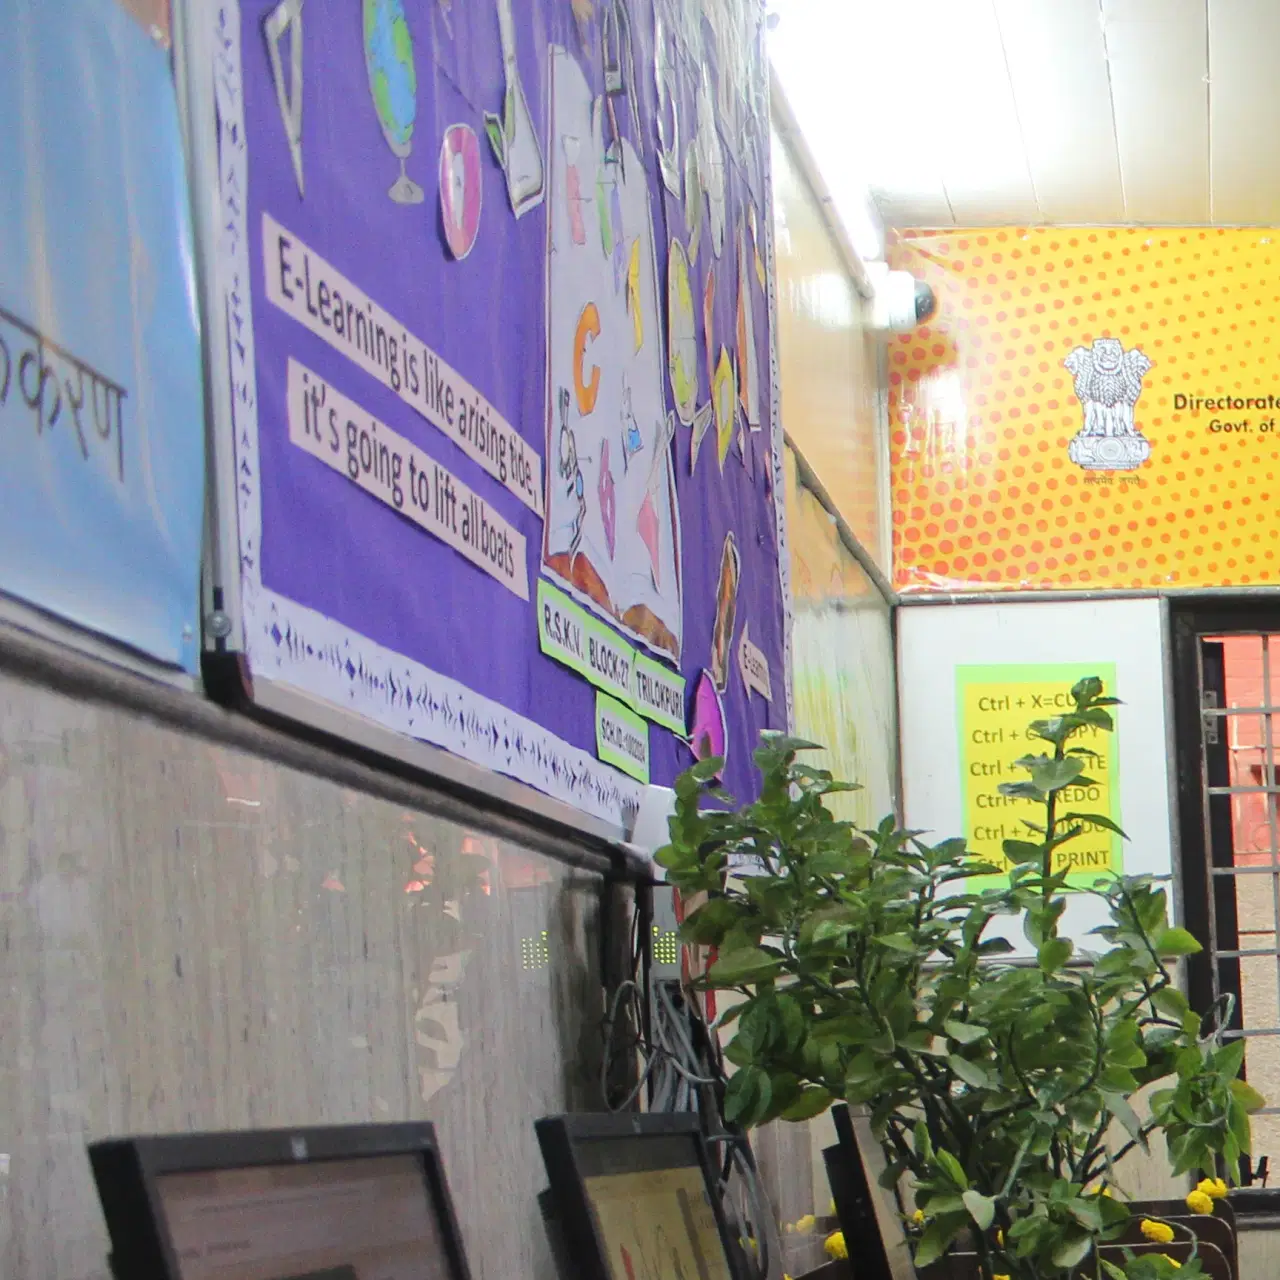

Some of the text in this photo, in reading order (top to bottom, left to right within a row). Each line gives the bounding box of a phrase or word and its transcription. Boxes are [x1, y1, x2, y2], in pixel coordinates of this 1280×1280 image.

[278, 235, 401, 392] E-Learning
[402, 333, 420, 395] is
[424, 348, 454, 424] like
[1209, 419, 1253, 433] Govt.
[1259, 419, 1276, 433] of
[302, 374, 514, 579] it's going to lift all boats
[978, 695, 1010, 711] Ctrl
[1031, 693, 1077, 708] X=CU
[972, 728, 1003, 743] Ctrl
[970, 760, 1001, 776] Ctrl
[974, 824, 1004, 840] Ctrl
